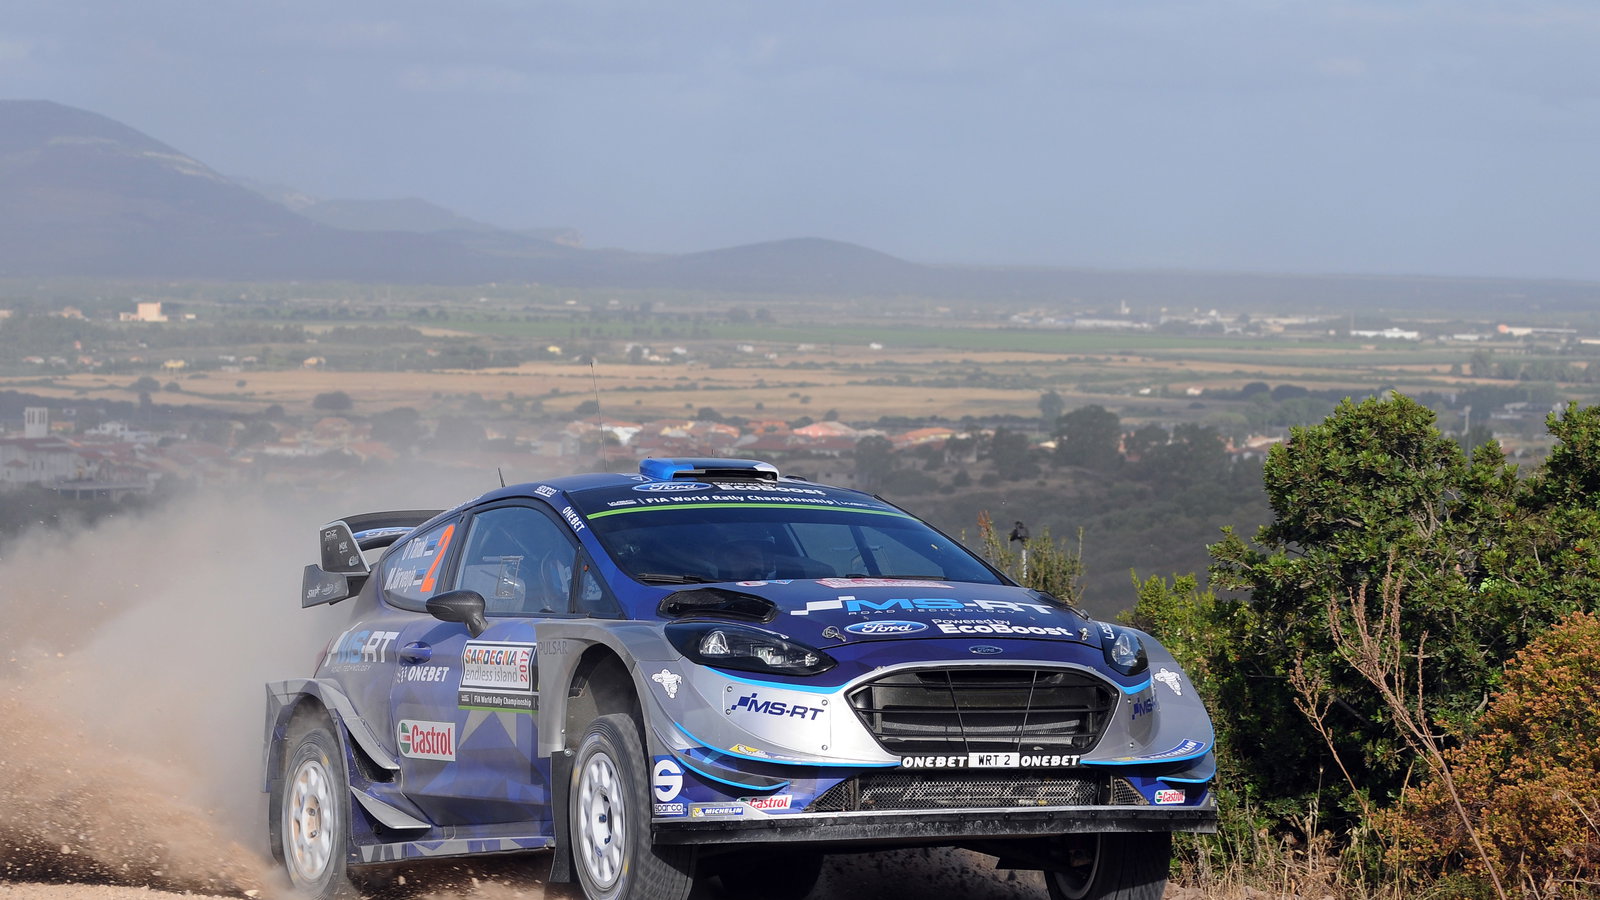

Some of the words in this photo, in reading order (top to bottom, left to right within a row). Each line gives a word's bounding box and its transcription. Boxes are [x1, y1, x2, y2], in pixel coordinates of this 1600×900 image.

[718, 485, 826, 496] EcoBoost
[747, 495, 834, 505] Championship
[562, 506, 585, 532] ONEBET
[420, 524, 456, 592] 2
[846, 598, 1054, 615] MS-RT
[862, 622, 912, 632] Ford
[992, 618, 1010, 626] by
[937, 623, 1074, 636] EcoBoost
[464, 648, 518, 666] SARDEGNA
[519, 650, 529, 682] 2017
[407, 665, 450, 682] ONEBET
[465, 664, 493, 682] endless
[494, 667, 518, 683] island
[746, 700, 824, 720] MS-RT
[411, 724, 453, 755] Castrol
[902, 756, 968, 767] ONEBET
[978, 755, 998, 766] WRT
[1003, 755, 1011, 766] 2
[1020, 755, 1080, 766] ONEBET
[749, 796, 789, 809] Castrol
[1162, 791, 1185, 803] Castrol
[705, 807, 743, 815] MICHELIN
